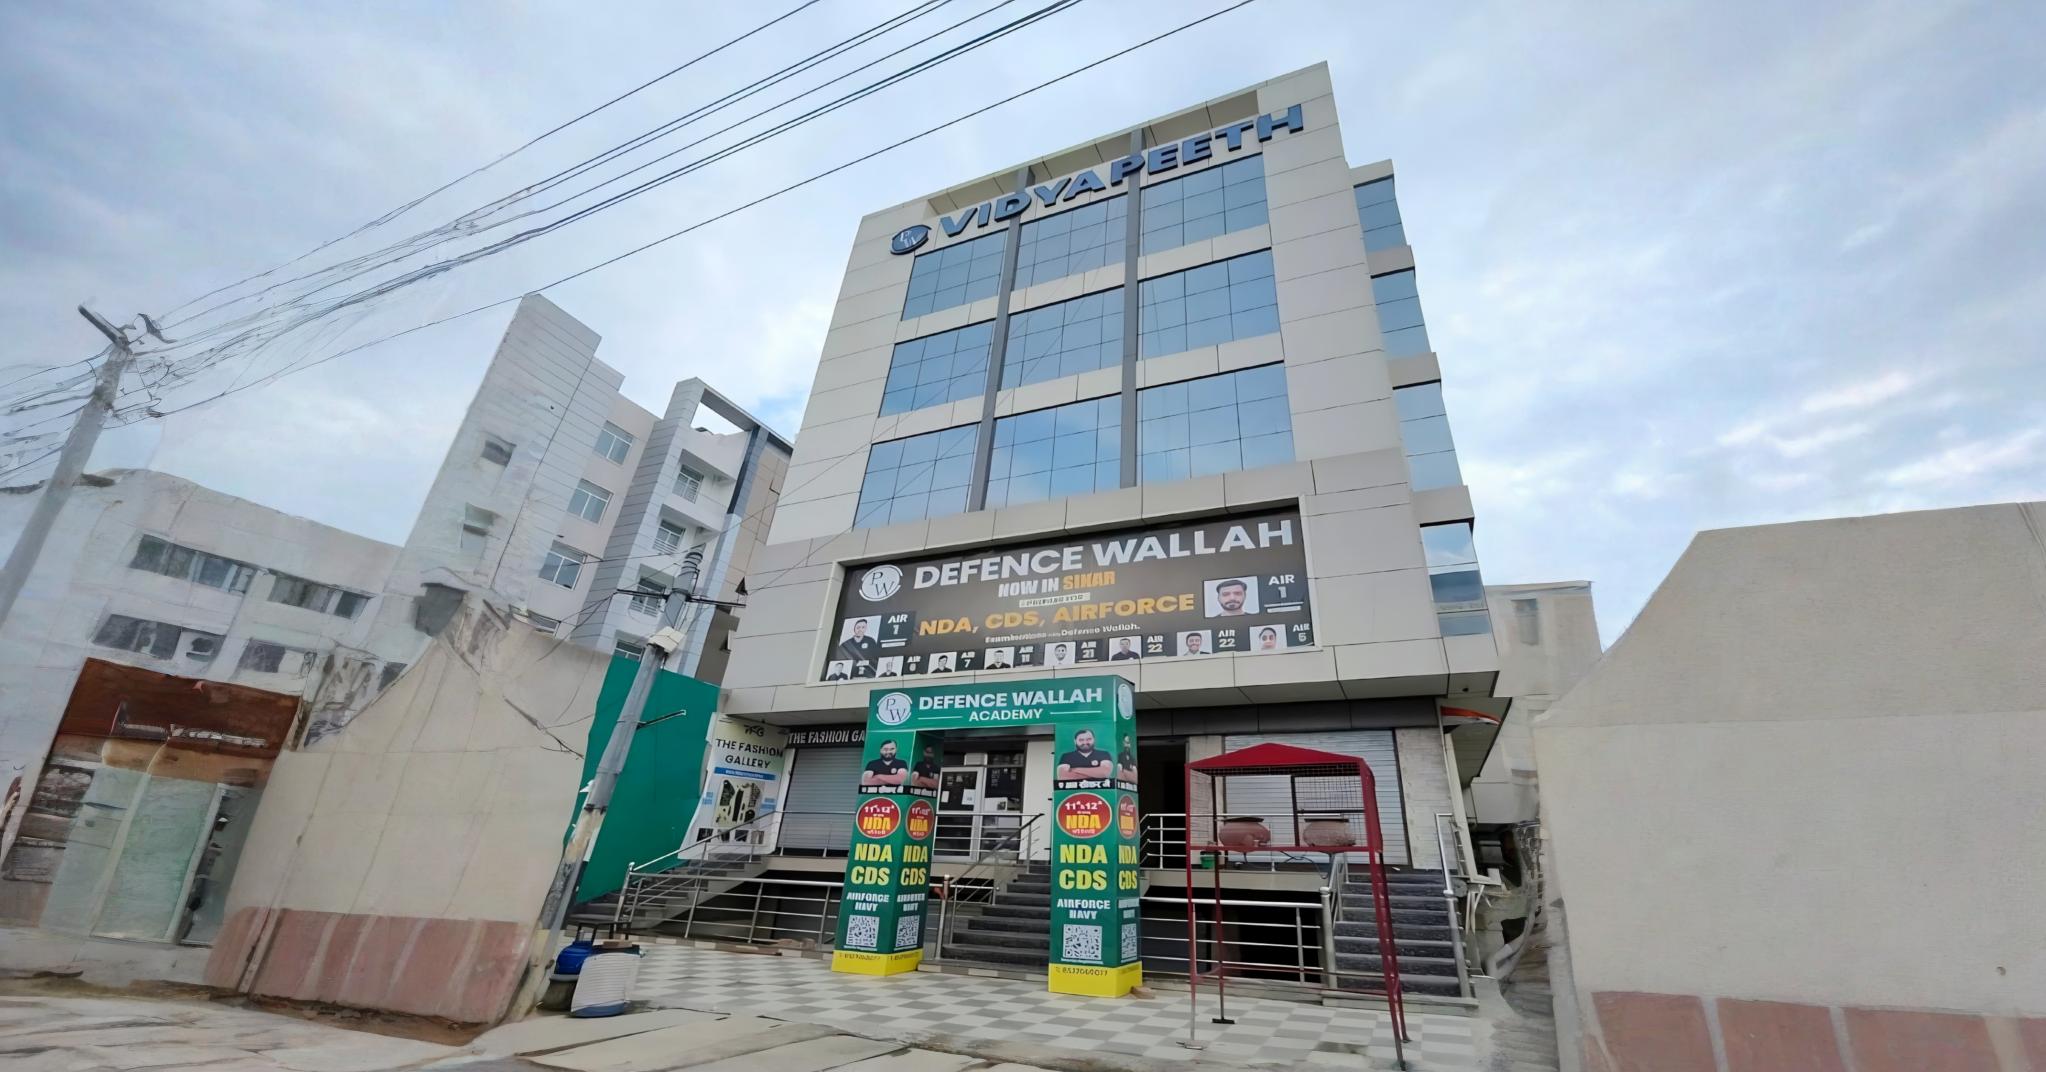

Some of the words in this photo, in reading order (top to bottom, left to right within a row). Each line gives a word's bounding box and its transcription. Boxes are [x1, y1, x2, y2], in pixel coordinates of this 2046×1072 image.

[940, 103, 1304, 237] VIDYAPEETH
[914, 546, 1084, 590] DEFENCE
[1091, 519, 1294, 566] WALLAH
[998, 579, 1039, 597] NOW
[1041, 577, 1060, 593] IN
[1269, 574, 1295, 585] AIR
[1278, 587, 1287, 598] 1
[888, 614, 908, 624] AIR
[919, 617, 978, 636] NDA,
[984, 611, 1045, 629] CDS,
[1053, 594, 1194, 624] AIRFORCE
[893, 624, 900, 635] 1
[1148, 644, 1164, 653] 22
[1219, 638, 1236, 648] 22
[919, 693, 1007, 710] DEFENCE
[1013, 688, 1102, 706] WALLAH
[969, 708, 1043, 722] ACADEMY
[789, 732, 806, 744] THE
[808, 731, 850, 743] FASHION
[716, 738, 736, 750] THE
[739, 742, 784, 758] FASHION
[725, 755, 771, 769] GALLERY
[1066, 814, 1101, 829] NDA
[854, 843, 893, 862] NDA
[903, 845, 928, 862] NDA
[1060, 844, 1108, 864] NDA
[1118, 845, 1137, 864] NDA
[850, 866, 891, 885] CDS
[900, 868, 926, 885] CDS
[1059, 869, 1107, 890] CDS
[1119, 870, 1137, 890] CDS
[846, 892, 890, 902] AIRFORCE
[1057, 898, 1111, 909] AIRFORCE
[855, 902, 878, 911] NAVY
[1069, 910, 1098, 919] NAVY
